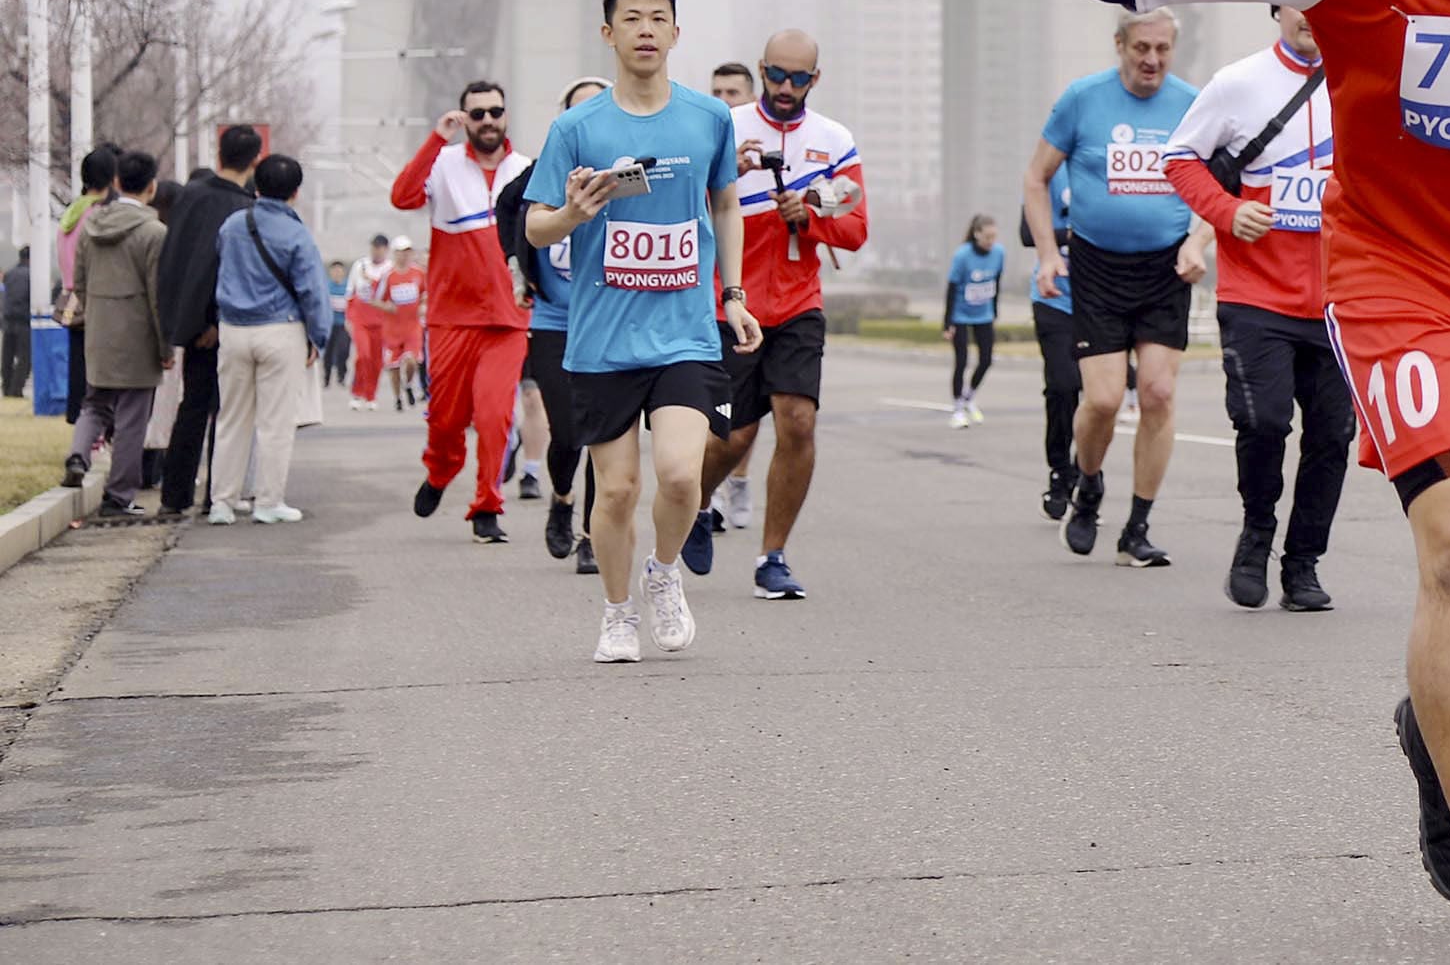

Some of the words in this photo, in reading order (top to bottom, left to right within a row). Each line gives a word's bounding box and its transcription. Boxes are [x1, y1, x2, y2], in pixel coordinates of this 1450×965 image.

[1111, 150, 1160, 172] 802
[610, 229, 694, 261] 8016
[605, 270, 696, 287] PYONGYANG
[1367, 349, 1440, 446] 10
